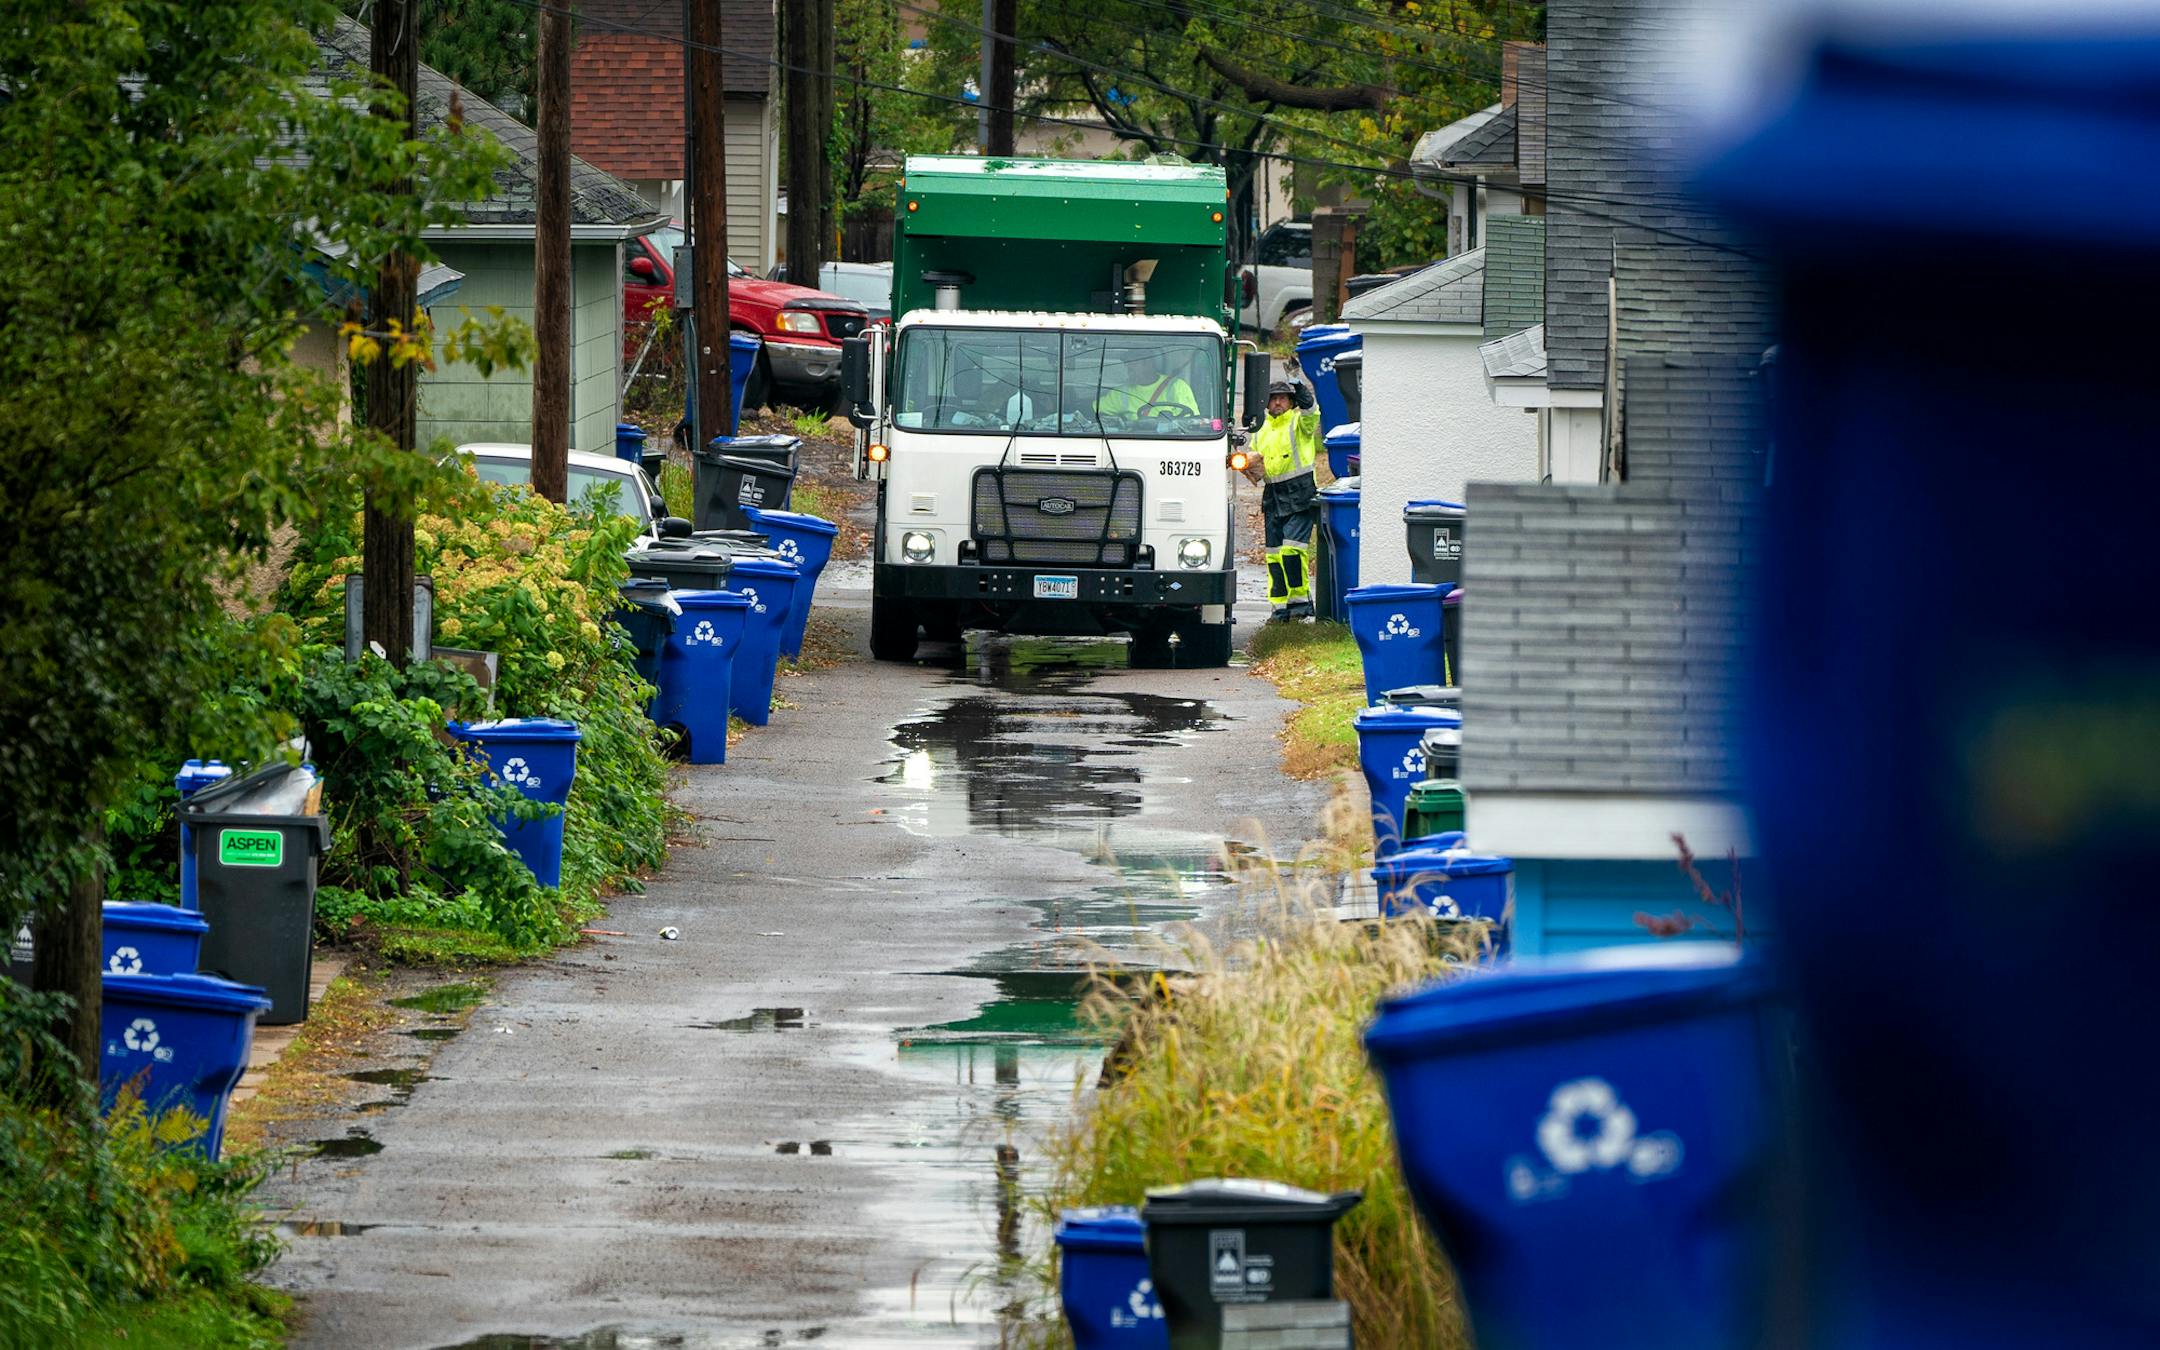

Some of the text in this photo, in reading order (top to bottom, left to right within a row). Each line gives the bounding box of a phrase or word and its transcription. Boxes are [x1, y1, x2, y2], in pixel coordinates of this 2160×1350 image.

[1160, 460, 1201, 476] 363729
[1042, 502, 1072, 510] AUTOCAR
[226, 836, 277, 851] ASPEN
